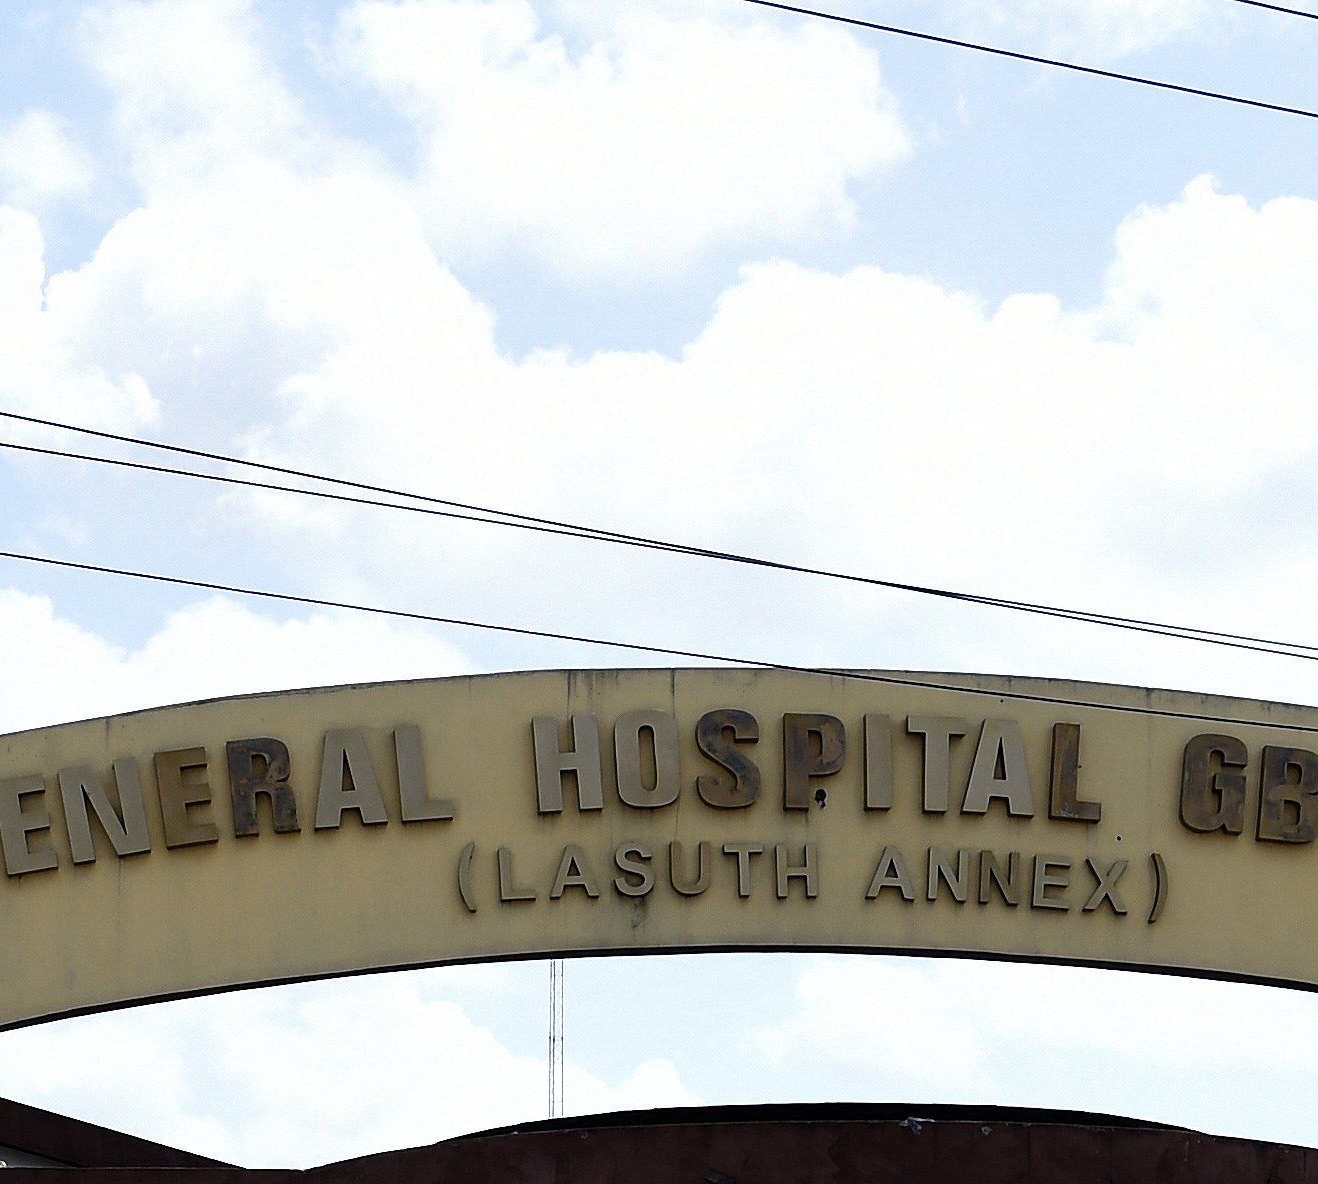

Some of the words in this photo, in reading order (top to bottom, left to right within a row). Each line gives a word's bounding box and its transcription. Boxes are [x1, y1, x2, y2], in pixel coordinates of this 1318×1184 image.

[531, 708, 1102, 823] HOSPITAL
[458, 840, 819, 912] (LASUTH
[864, 844, 1169, 924] ANNEX)
